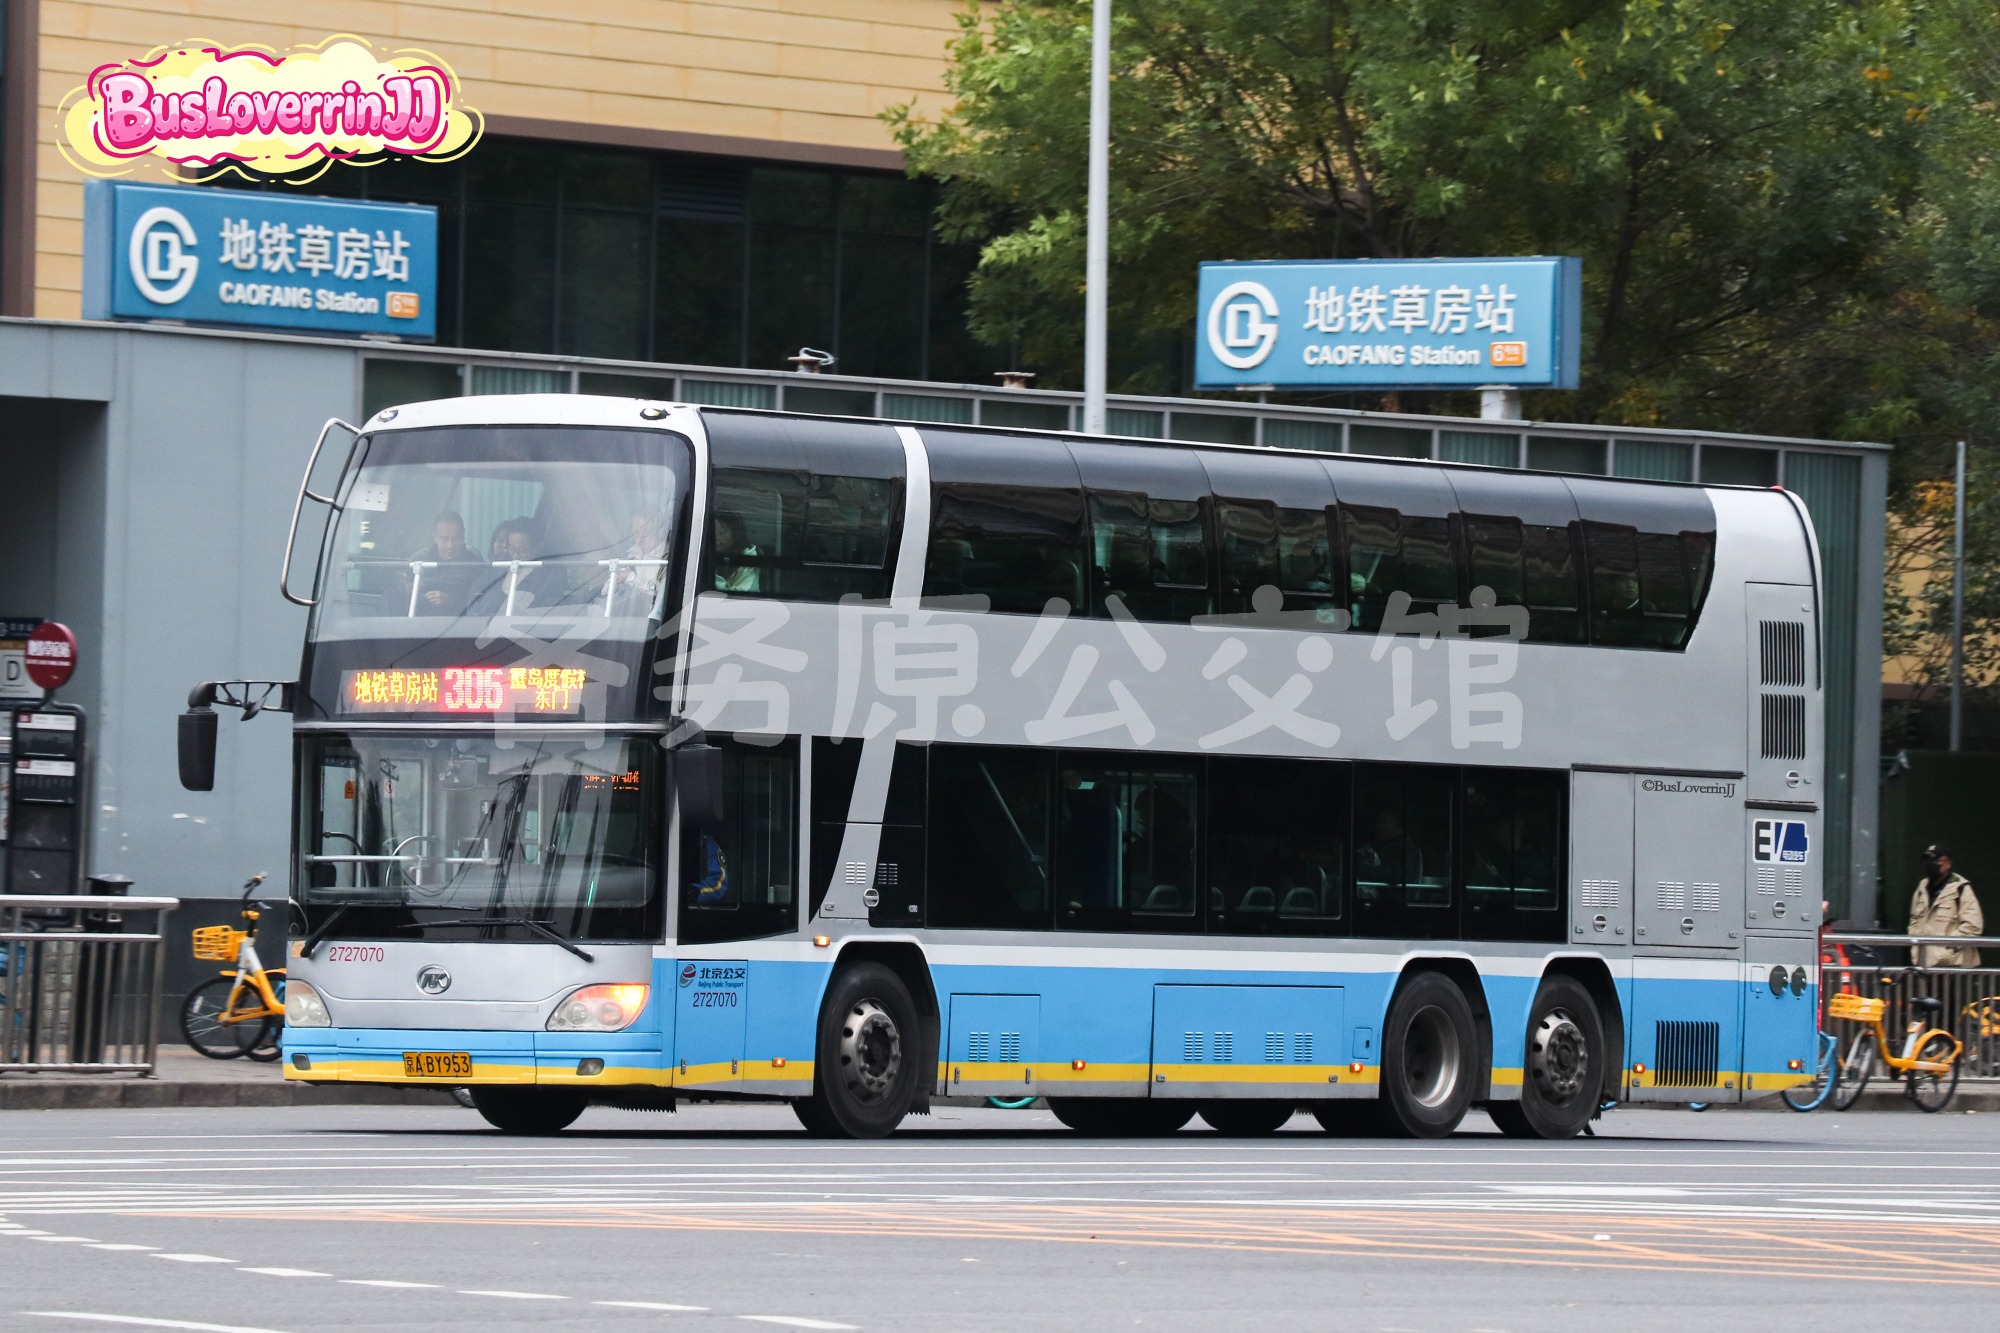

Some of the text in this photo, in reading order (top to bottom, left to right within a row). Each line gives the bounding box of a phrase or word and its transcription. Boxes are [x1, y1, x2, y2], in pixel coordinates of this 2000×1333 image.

[218, 217, 411, 283] 地铁草房站
[219, 281, 313, 310] CAOFANG
[315, 288, 380, 314] Station
[1303, 284, 1518, 335] 地铁草房站
[1303, 344, 1405, 367] CAOFANG
[1410, 345, 1481, 366] Station
[6, 660, 20, 681] D
[355, 671, 439, 704] 地铁草房站
[534, 687, 569, 710] 东门
[329, 946, 384, 962] 2727070
[699, 967, 746, 979] 北京公交
[698, 981, 711, 989] Beijing
[725, 981, 744, 989] Transport
[693, 992, 737, 1007] 2727070
